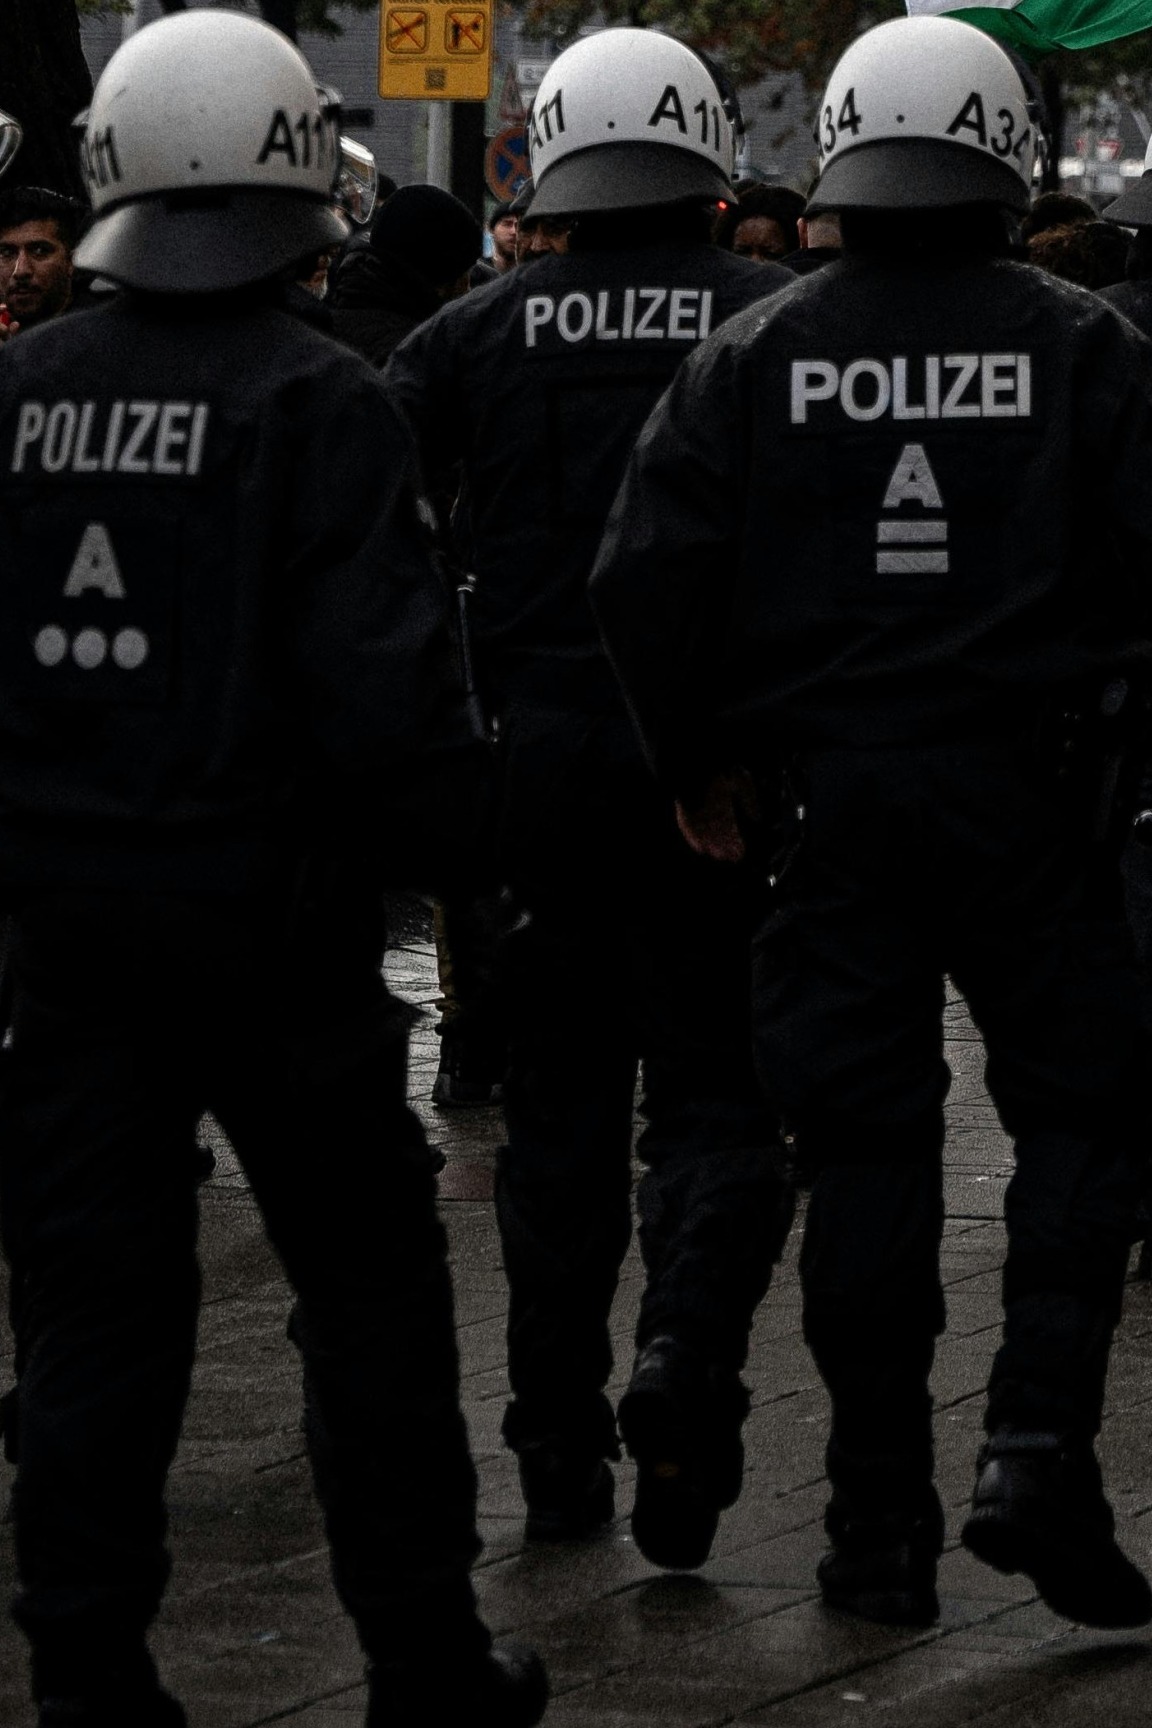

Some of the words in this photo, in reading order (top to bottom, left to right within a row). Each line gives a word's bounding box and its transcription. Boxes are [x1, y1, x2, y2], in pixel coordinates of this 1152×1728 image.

[648, 84, 720, 151] A11
[525, 288, 713, 348] POLIZEI
[790, 353, 1032, 424] POLIZEI
[11, 400, 209, 476] POLIZEI
[883, 443, 943, 508] A
[63, 521, 127, 598] A
